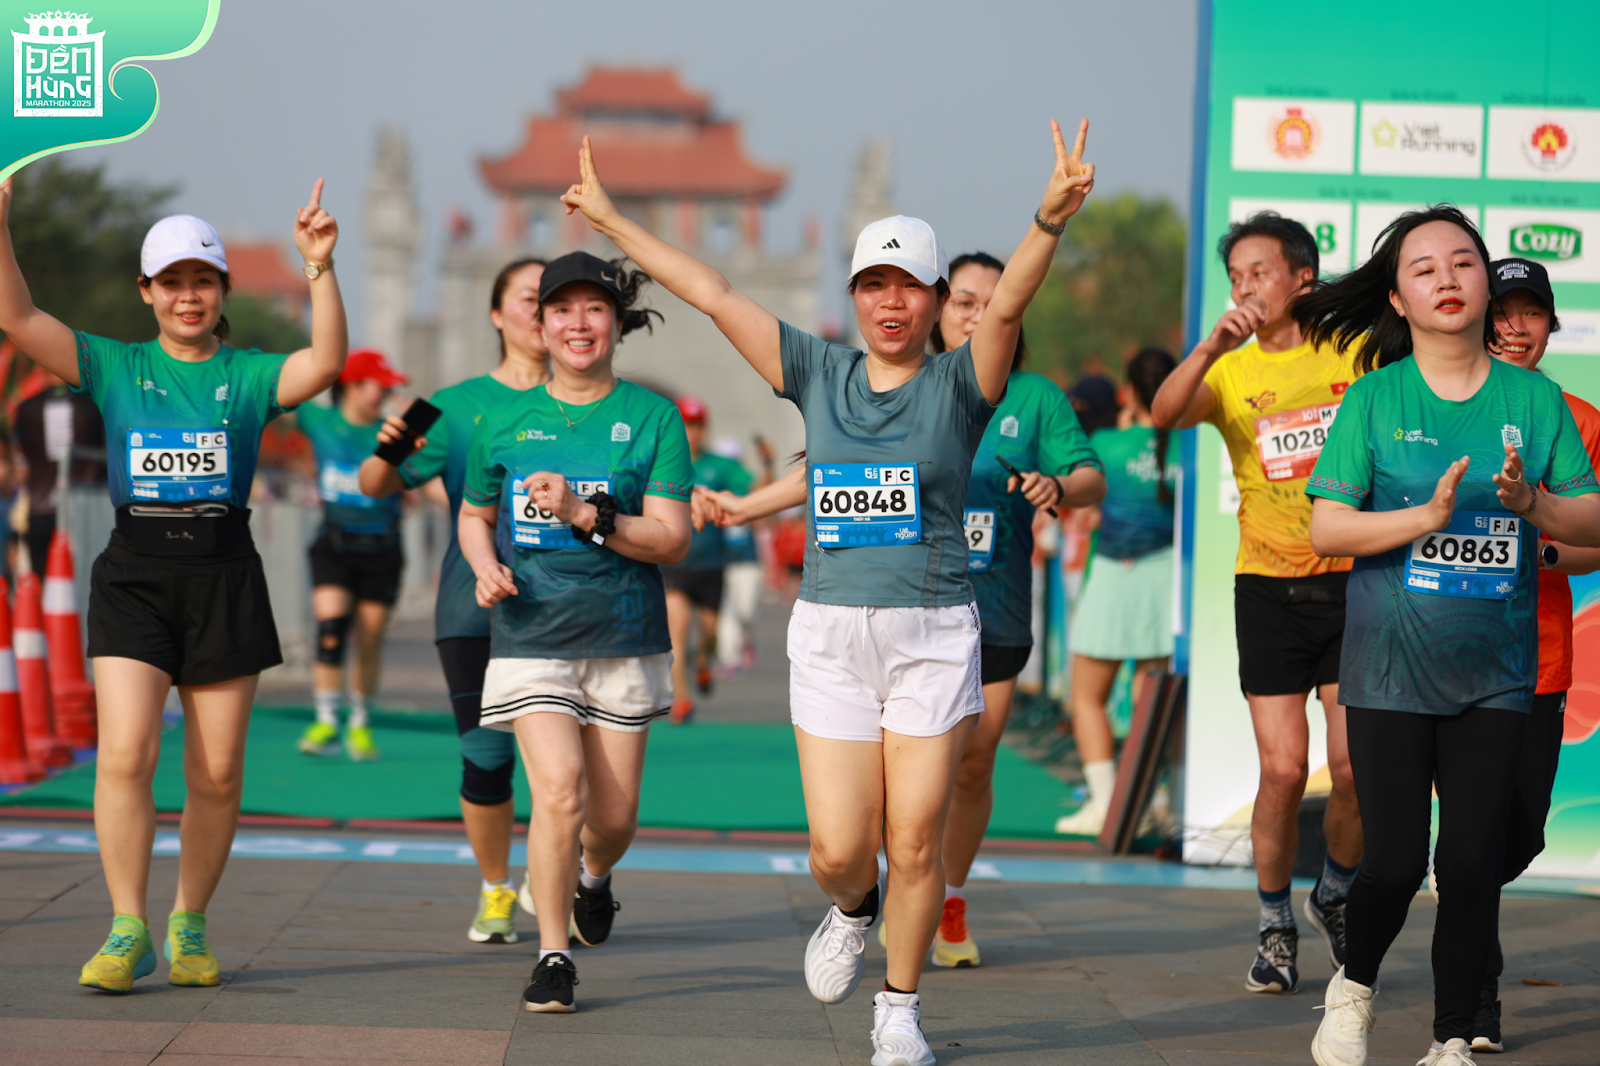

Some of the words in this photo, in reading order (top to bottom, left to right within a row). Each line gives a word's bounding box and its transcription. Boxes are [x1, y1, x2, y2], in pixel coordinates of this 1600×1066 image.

[1401, 137, 1476, 157] Running
[1513, 230, 1577, 259] Cozy
[1322, 409, 1332, 420] M
[201, 435, 208, 446] F
[214, 434, 224, 445] C
[1271, 425, 1332, 454] 1028
[1404, 435, 1438, 446] Running
[142, 452, 217, 473] 60195
[884, 470, 892, 482] F
[899, 470, 910, 481] C
[582, 484, 589, 493] F
[820, 489, 907, 514] 60848
[971, 515, 978, 524] F
[983, 514, 990, 524] B
[1493, 520, 1501, 533] F
[1506, 520, 1516, 533] A
[1421, 535, 1509, 565] 60863
